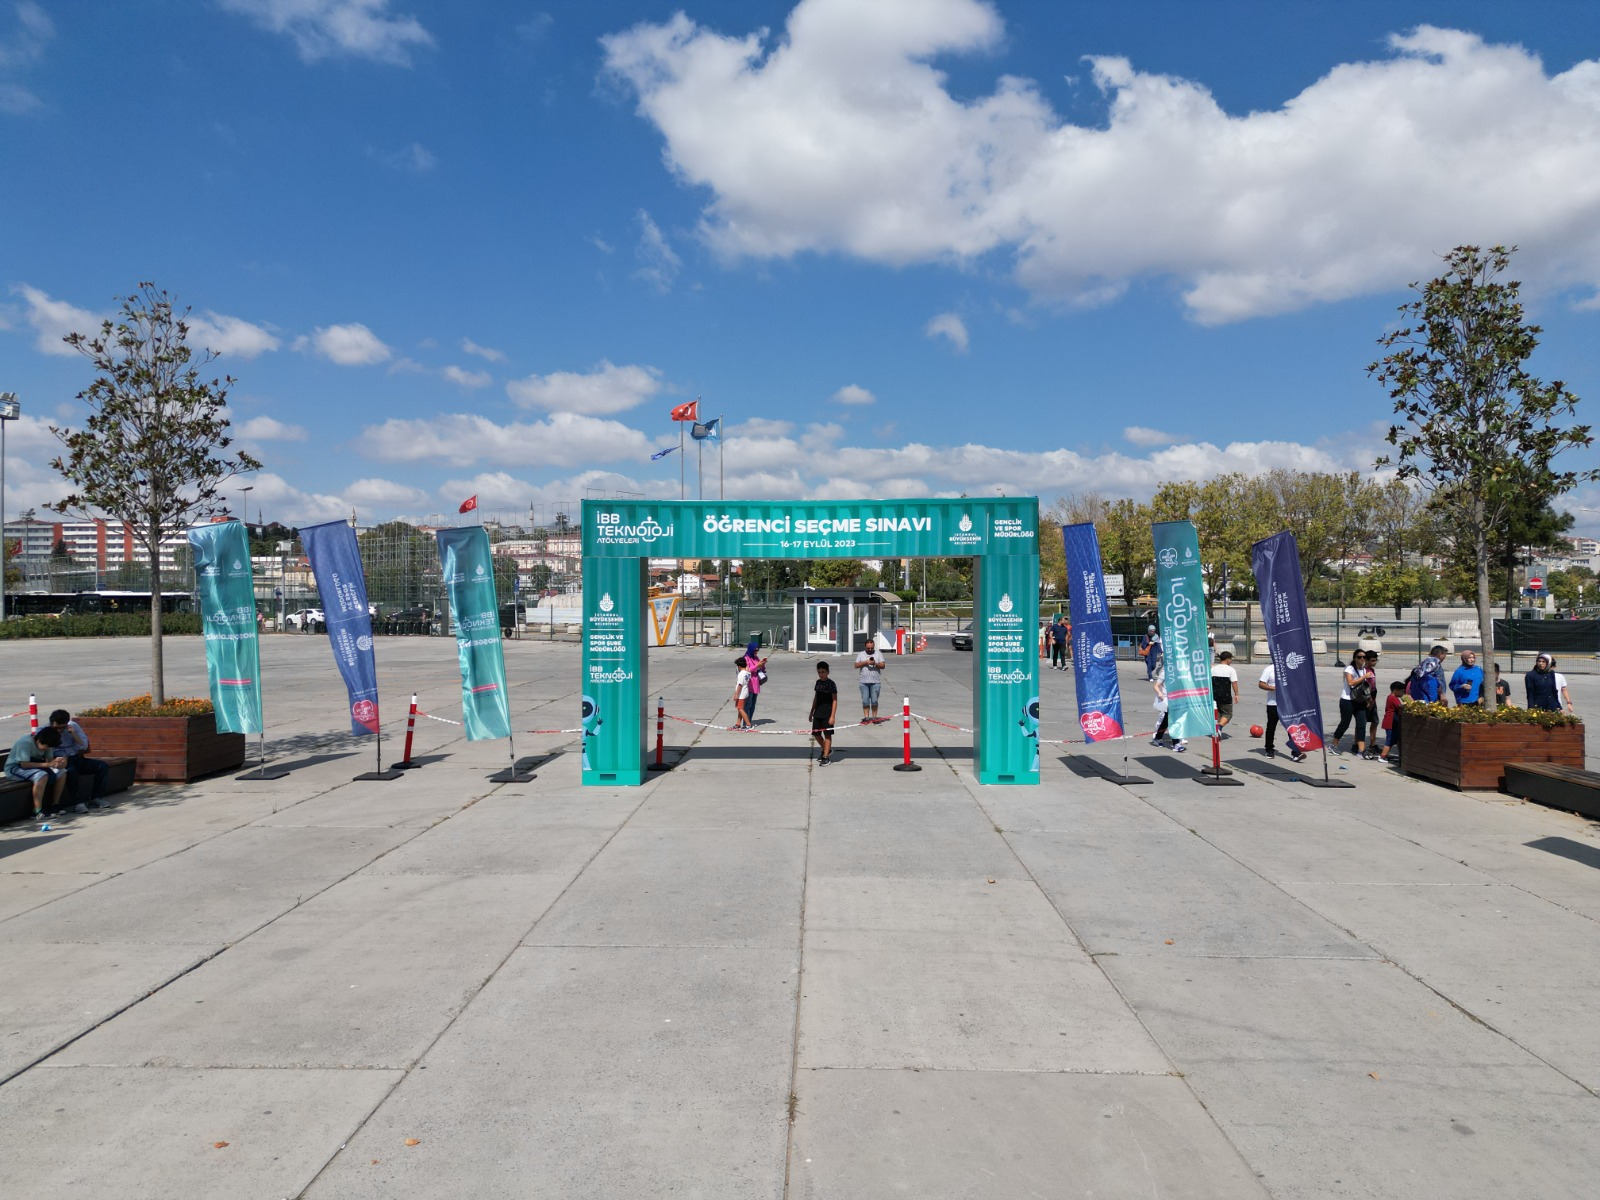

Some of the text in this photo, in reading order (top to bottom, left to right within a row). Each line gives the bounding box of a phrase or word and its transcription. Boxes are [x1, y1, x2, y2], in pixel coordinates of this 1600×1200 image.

[597, 511, 620, 524] İBB
[703, 514, 931, 535] ÖĞRENCİ SEÇME SINAVI
[804, 540, 833, 548] EYLÜL
